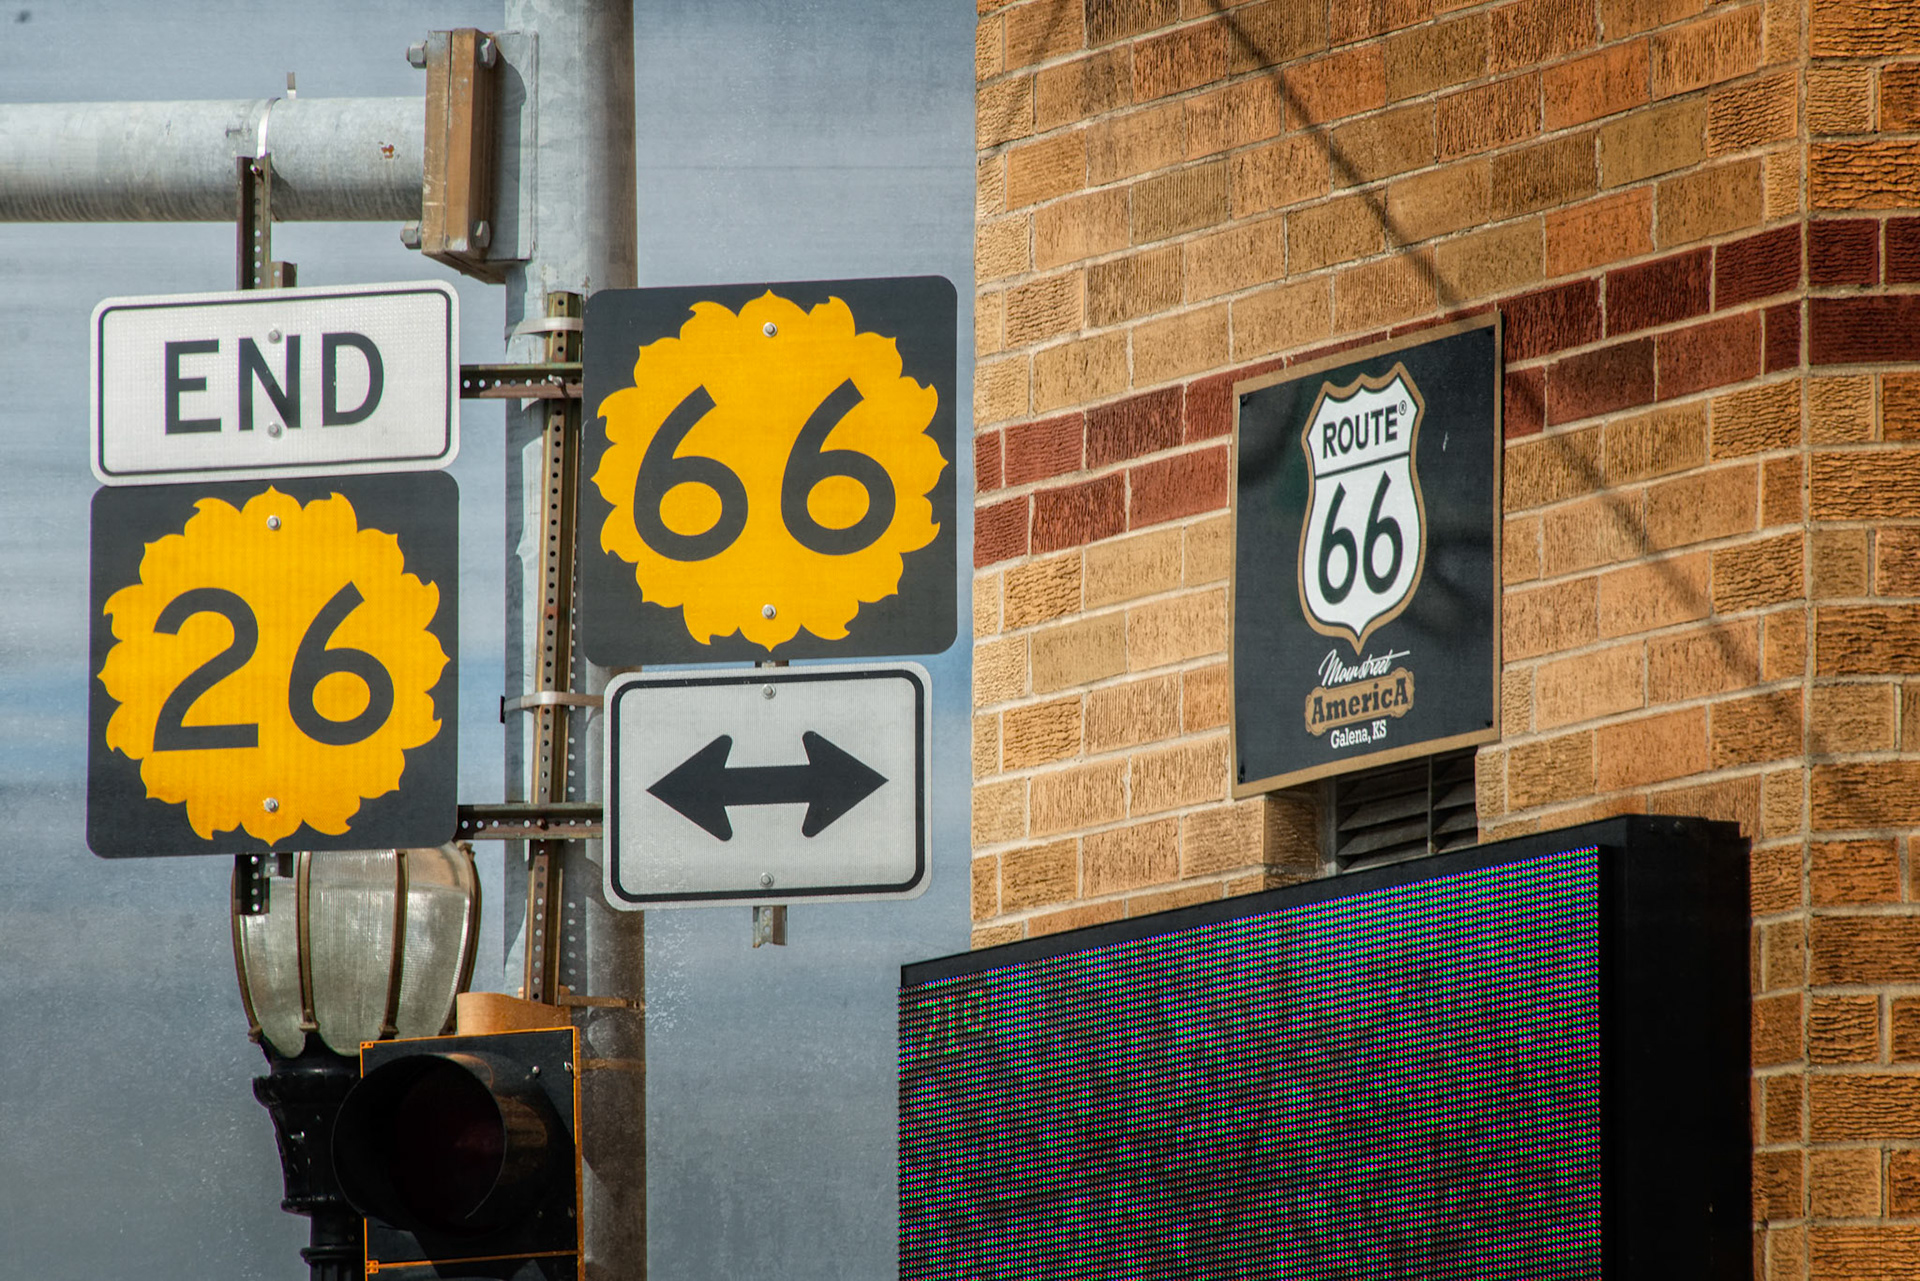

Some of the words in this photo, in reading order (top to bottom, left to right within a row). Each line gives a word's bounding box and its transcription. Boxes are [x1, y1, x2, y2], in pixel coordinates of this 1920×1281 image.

[165, 332, 384, 435] END
[633, 377, 896, 562] 66
[1318, 470, 1404, 606] 66
[152, 580, 395, 753] 26
[1330, 727, 1372, 749] Galena,
[1371, 719, 1387, 741] KS
